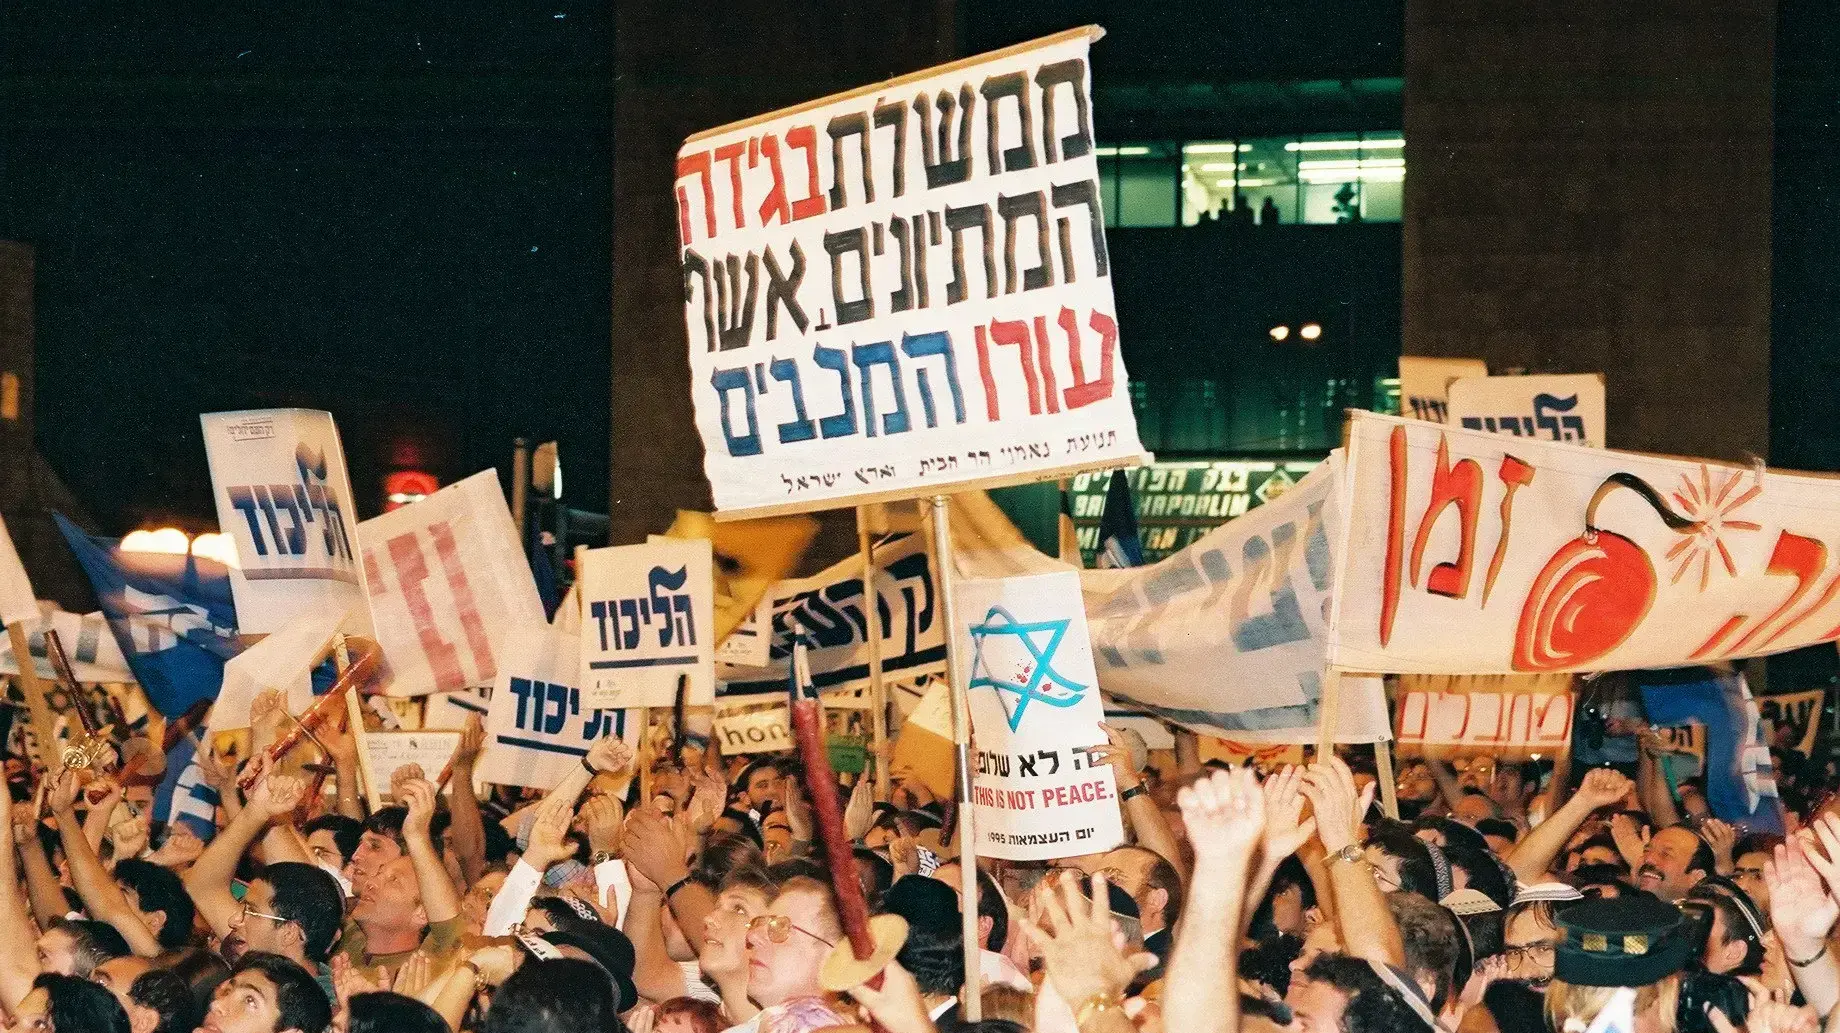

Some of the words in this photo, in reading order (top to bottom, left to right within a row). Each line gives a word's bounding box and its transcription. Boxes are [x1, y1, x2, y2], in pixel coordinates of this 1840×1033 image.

[828, 58, 1093, 210] ממשלת
[677, 124, 828, 245] בגידה
[974, 305, 1119, 422] עורו
[710, 330, 967, 457] המכבים
[1066, 430, 1118, 453] תנועת
[919, 455, 958, 476] הבית
[967, 450, 991, 466] הר
[780, 472, 841, 494] ישראל
[226, 441, 354, 561] הליכוד
[1379, 425, 1536, 649] זמן
[591, 564, 697, 651] הליכוד
[1017, 750, 1060, 778] לא
[974, 785, 994, 808] THIS
[995, 787, 1005, 809] IS
[1007, 790, 1035, 811] NOT
[1042, 780, 1115, 809] PEACE.
[988, 831, 1006, 845] 1995
[1008, 831, 1070, 846] העצמאות
[1076, 827, 1095, 840] יום
